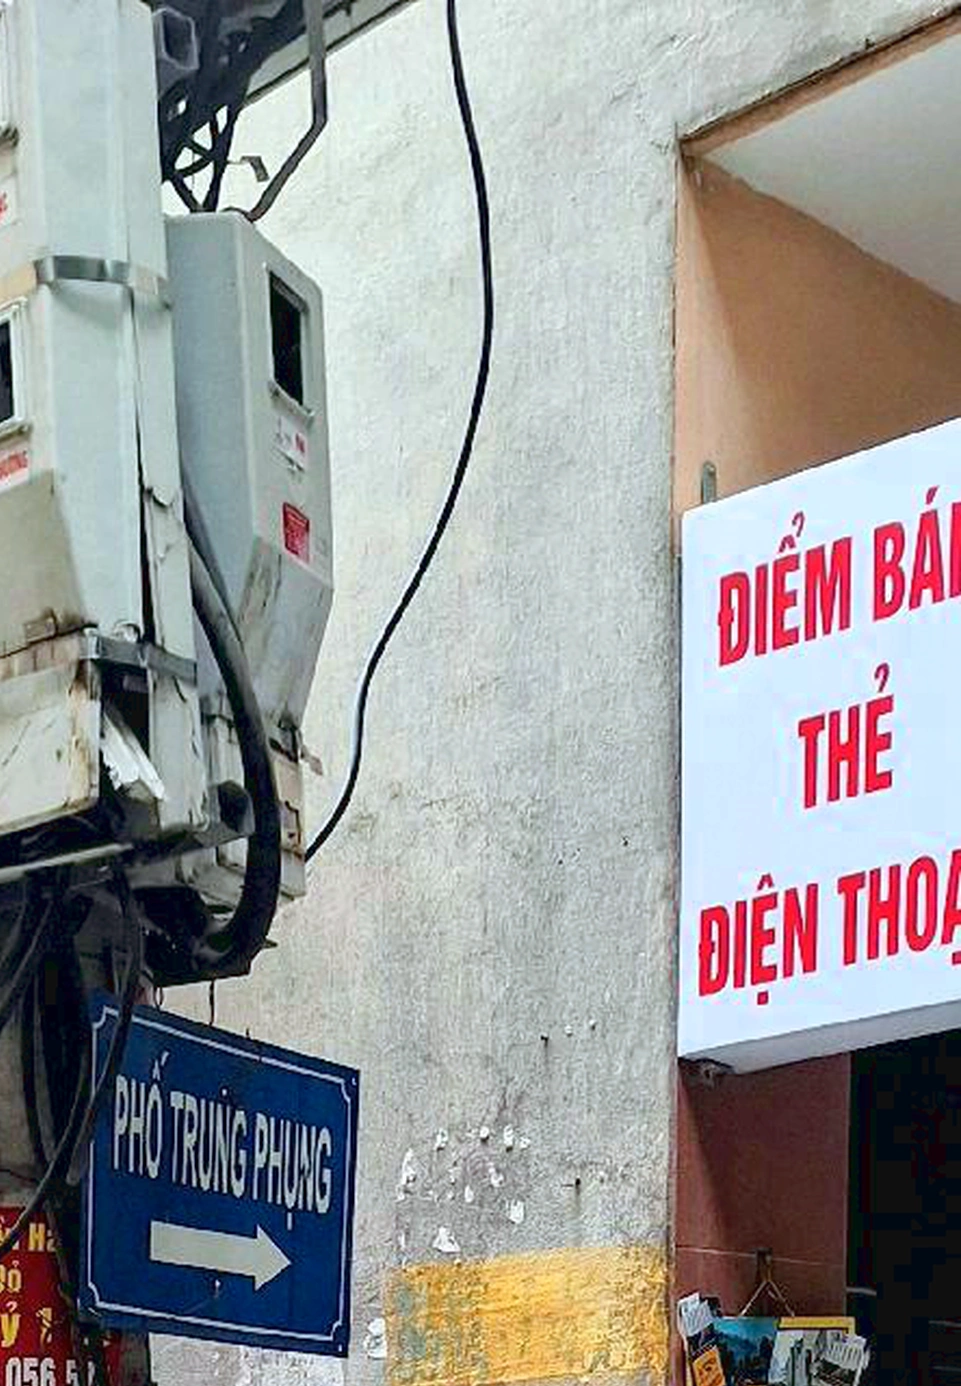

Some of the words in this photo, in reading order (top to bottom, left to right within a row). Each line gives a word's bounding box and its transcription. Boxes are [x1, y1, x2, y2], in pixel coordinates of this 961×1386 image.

[718, 512, 852, 667] ĐIỂM
[798, 663, 894, 808] THẺ
[698, 874, 819, 1005] ĐIỆN
[114, 1051, 170, 1180] PHỐ
[170, 1091, 247, 1199] TRUNG
[253, 1113, 332, 1230] PHỤNG
